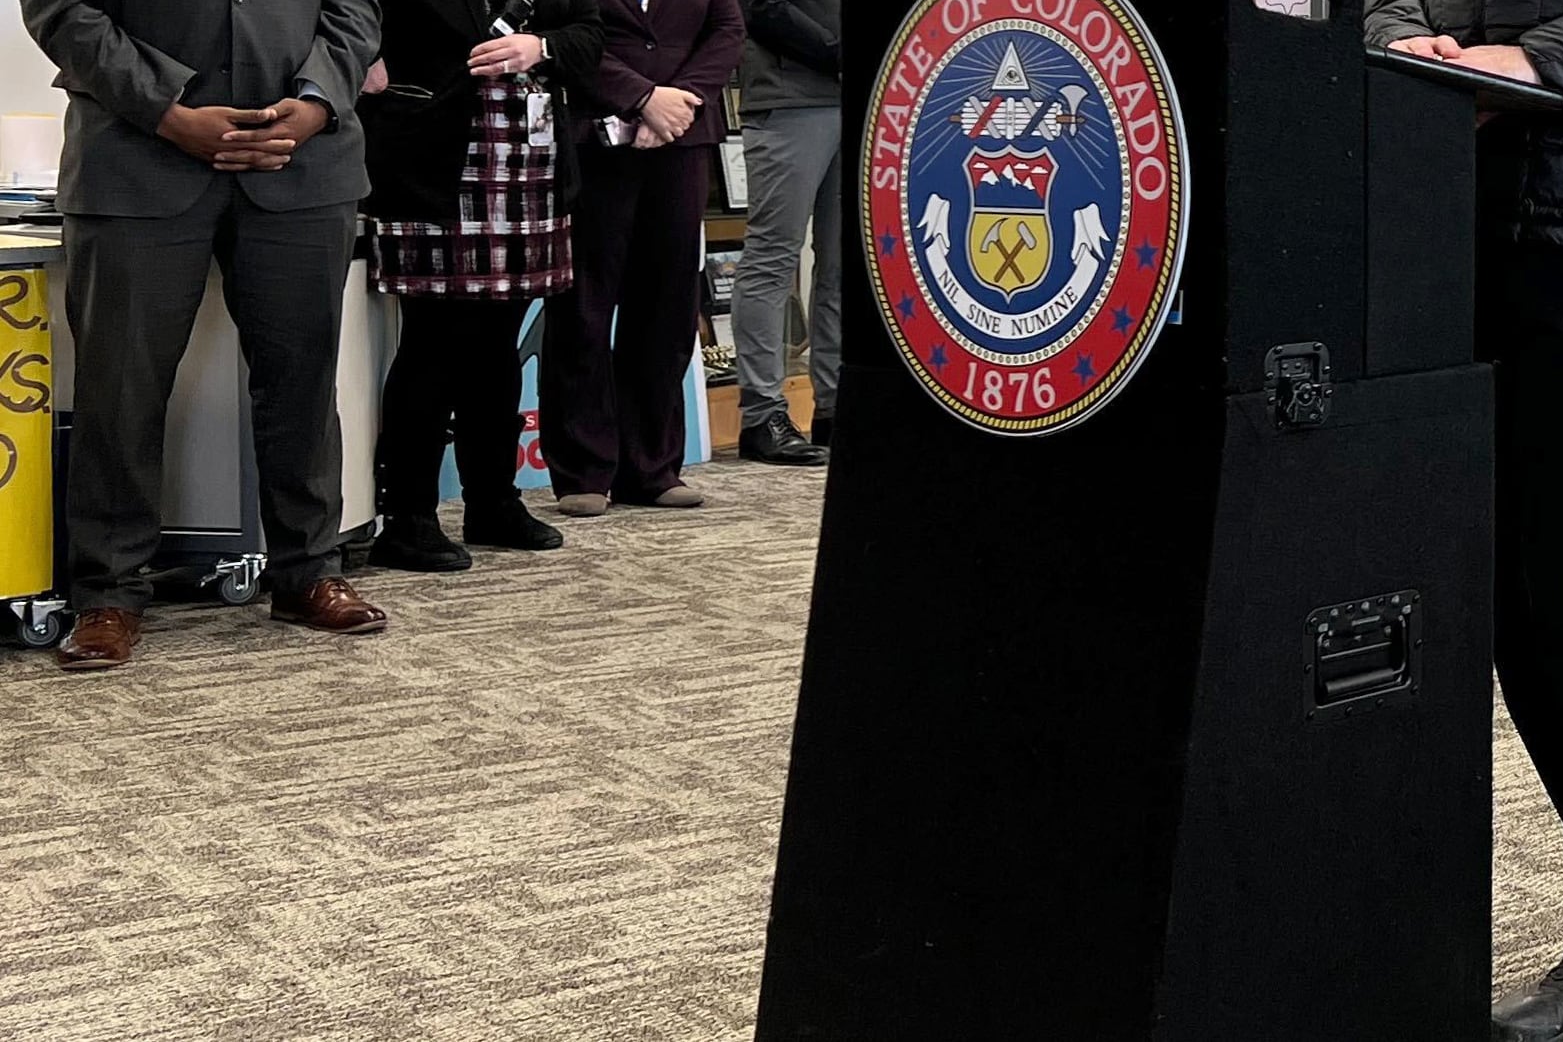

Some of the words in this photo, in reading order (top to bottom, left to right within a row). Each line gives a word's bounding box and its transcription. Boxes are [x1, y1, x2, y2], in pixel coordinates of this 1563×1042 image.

[874, 34, 934, 191] STATE
[937, 269, 960, 307] NIL
[966, 302, 1002, 335] SINE
[1010, 285, 1079, 337] NUMINE
[962, 360, 1056, 412] 1876
